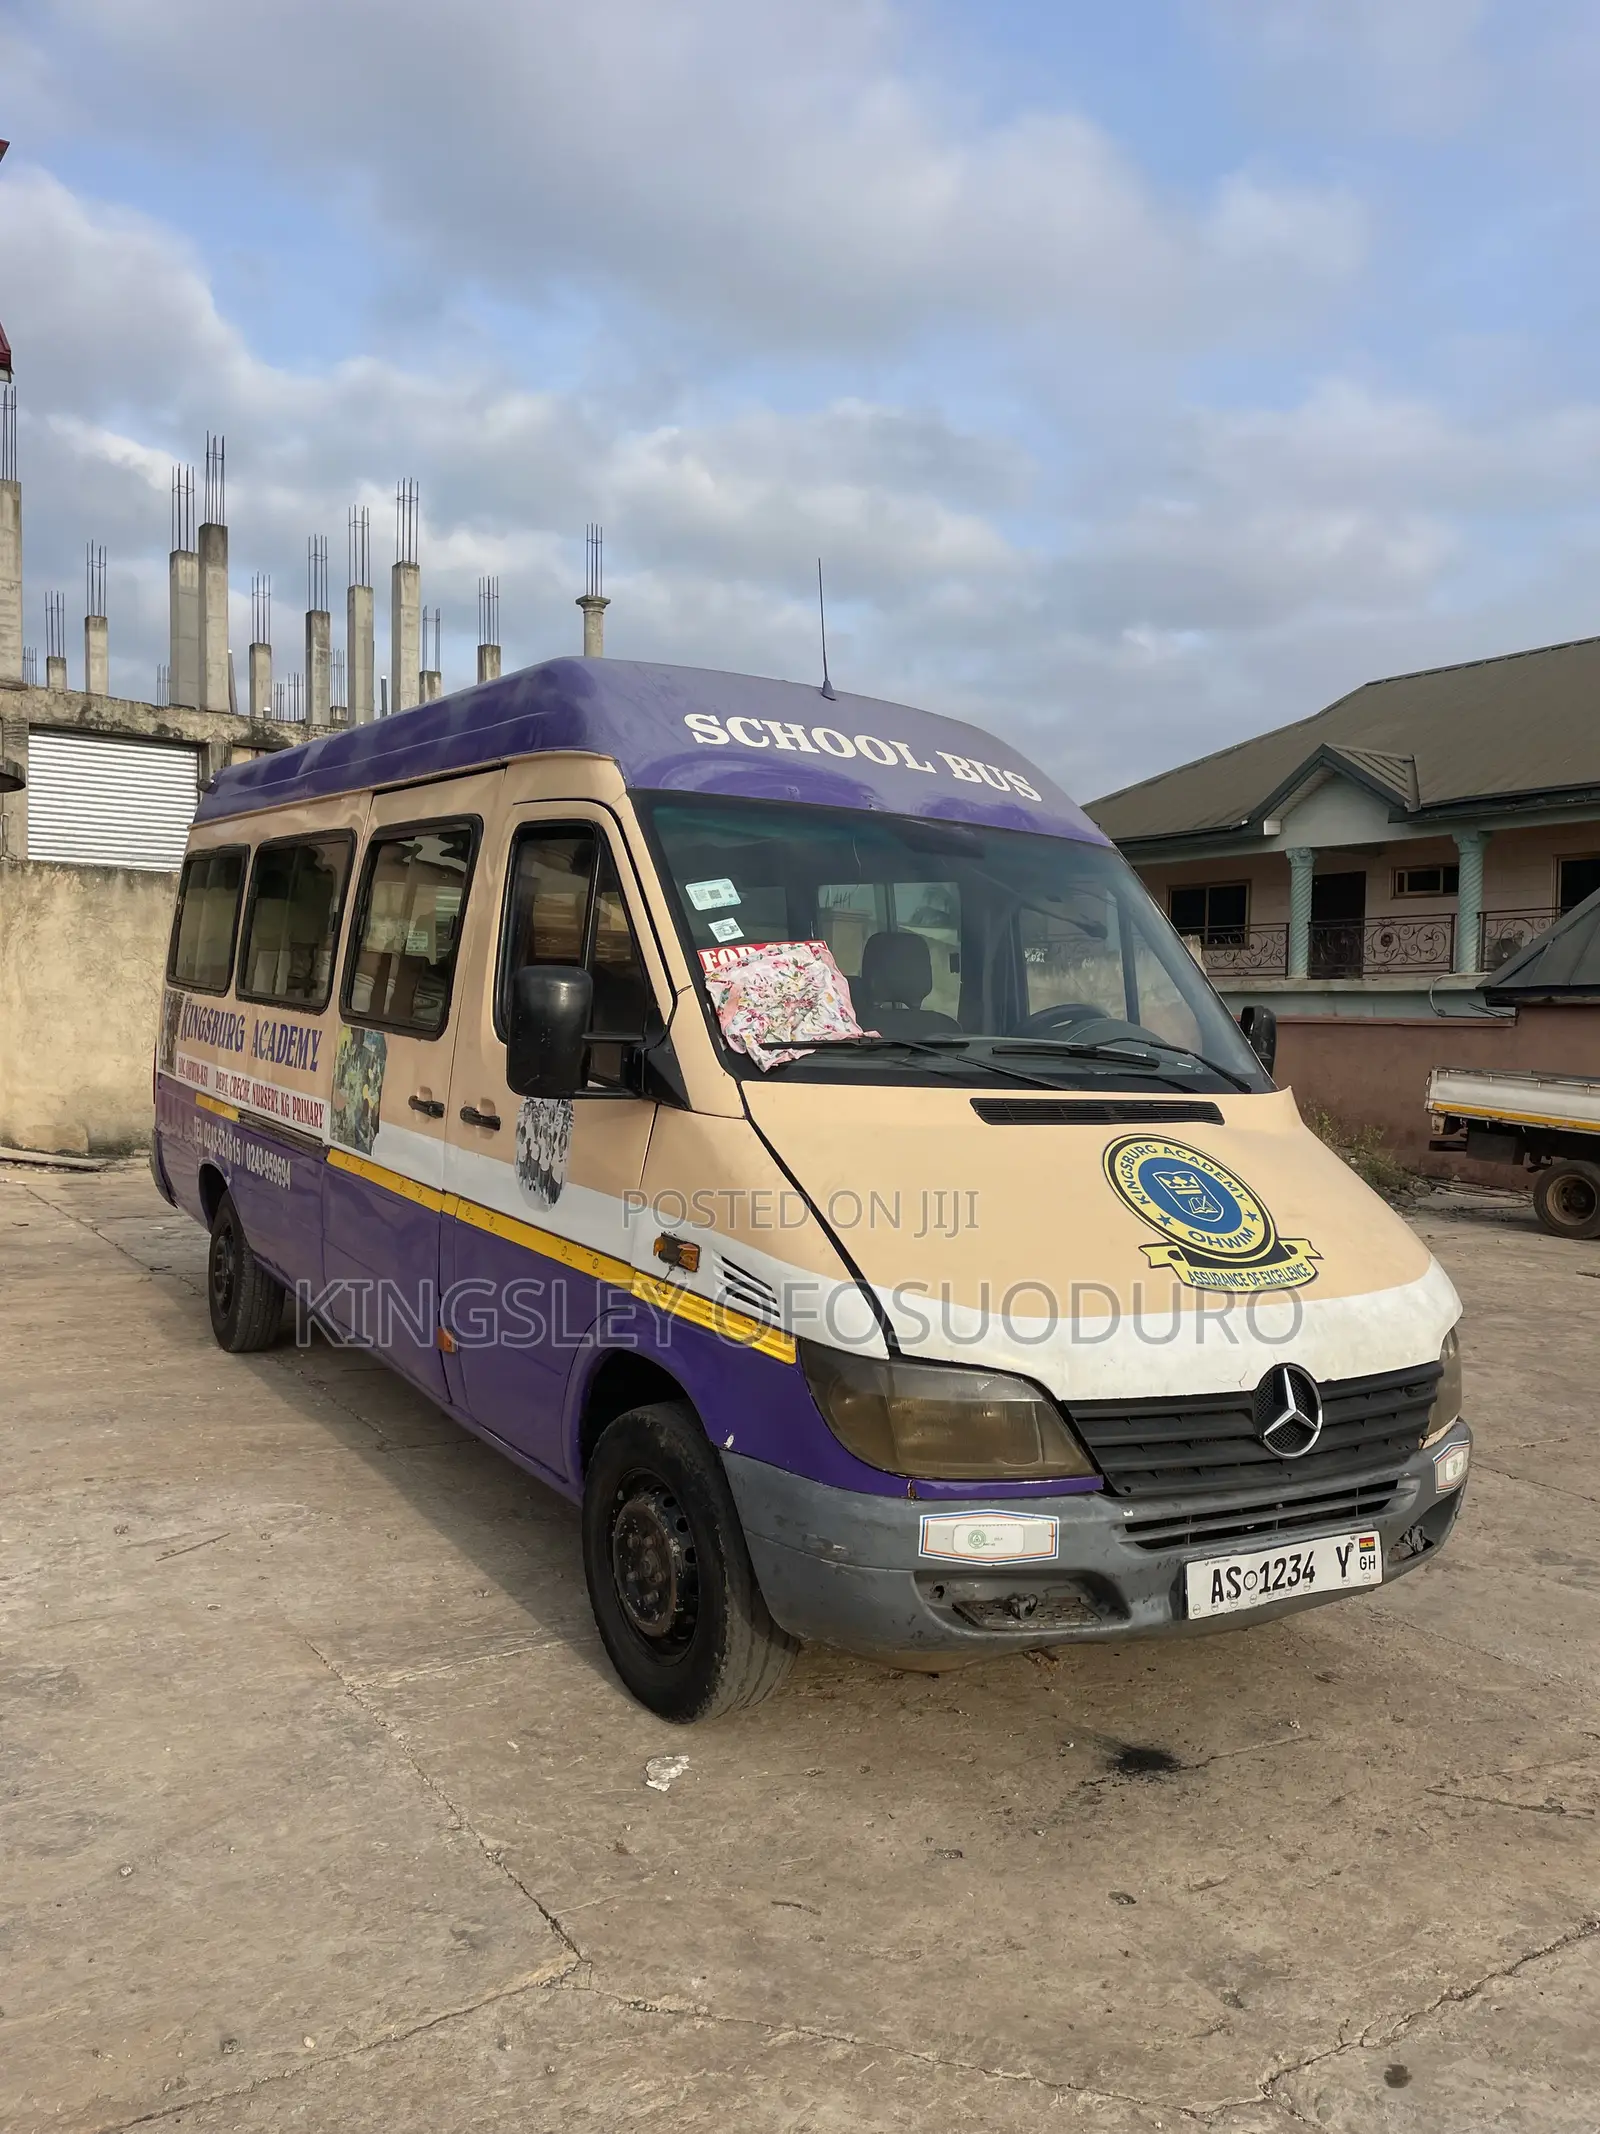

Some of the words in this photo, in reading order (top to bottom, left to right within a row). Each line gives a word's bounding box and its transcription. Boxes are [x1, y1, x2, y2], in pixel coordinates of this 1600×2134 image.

[684, 713, 937, 774] SCHOOL
[935, 750, 1043, 802] BUS
[180, 1003, 246, 1053] KINGSBURG
[250, 1019, 323, 1073] ACADEMY
[292, 1096, 325, 1129] PRIMARY
[1120, 1144, 1158, 1206] KINGSBURG
[1163, 1146, 1249, 1202] ACADEMY
[1187, 1227, 1257, 1249] OHWIM
[1187, 1269, 1250, 1288] ASSURANCE
[1247, 1271, 1263, 1287] OF
[1259, 1263, 1311, 1287] EXCELLENCE
[1210, 1566, 1242, 1605] AS
[1258, 1550, 1316, 1595] 1234
[1335, 1542, 1351, 1578] Y
[1359, 1554, 1376, 1571] GH
